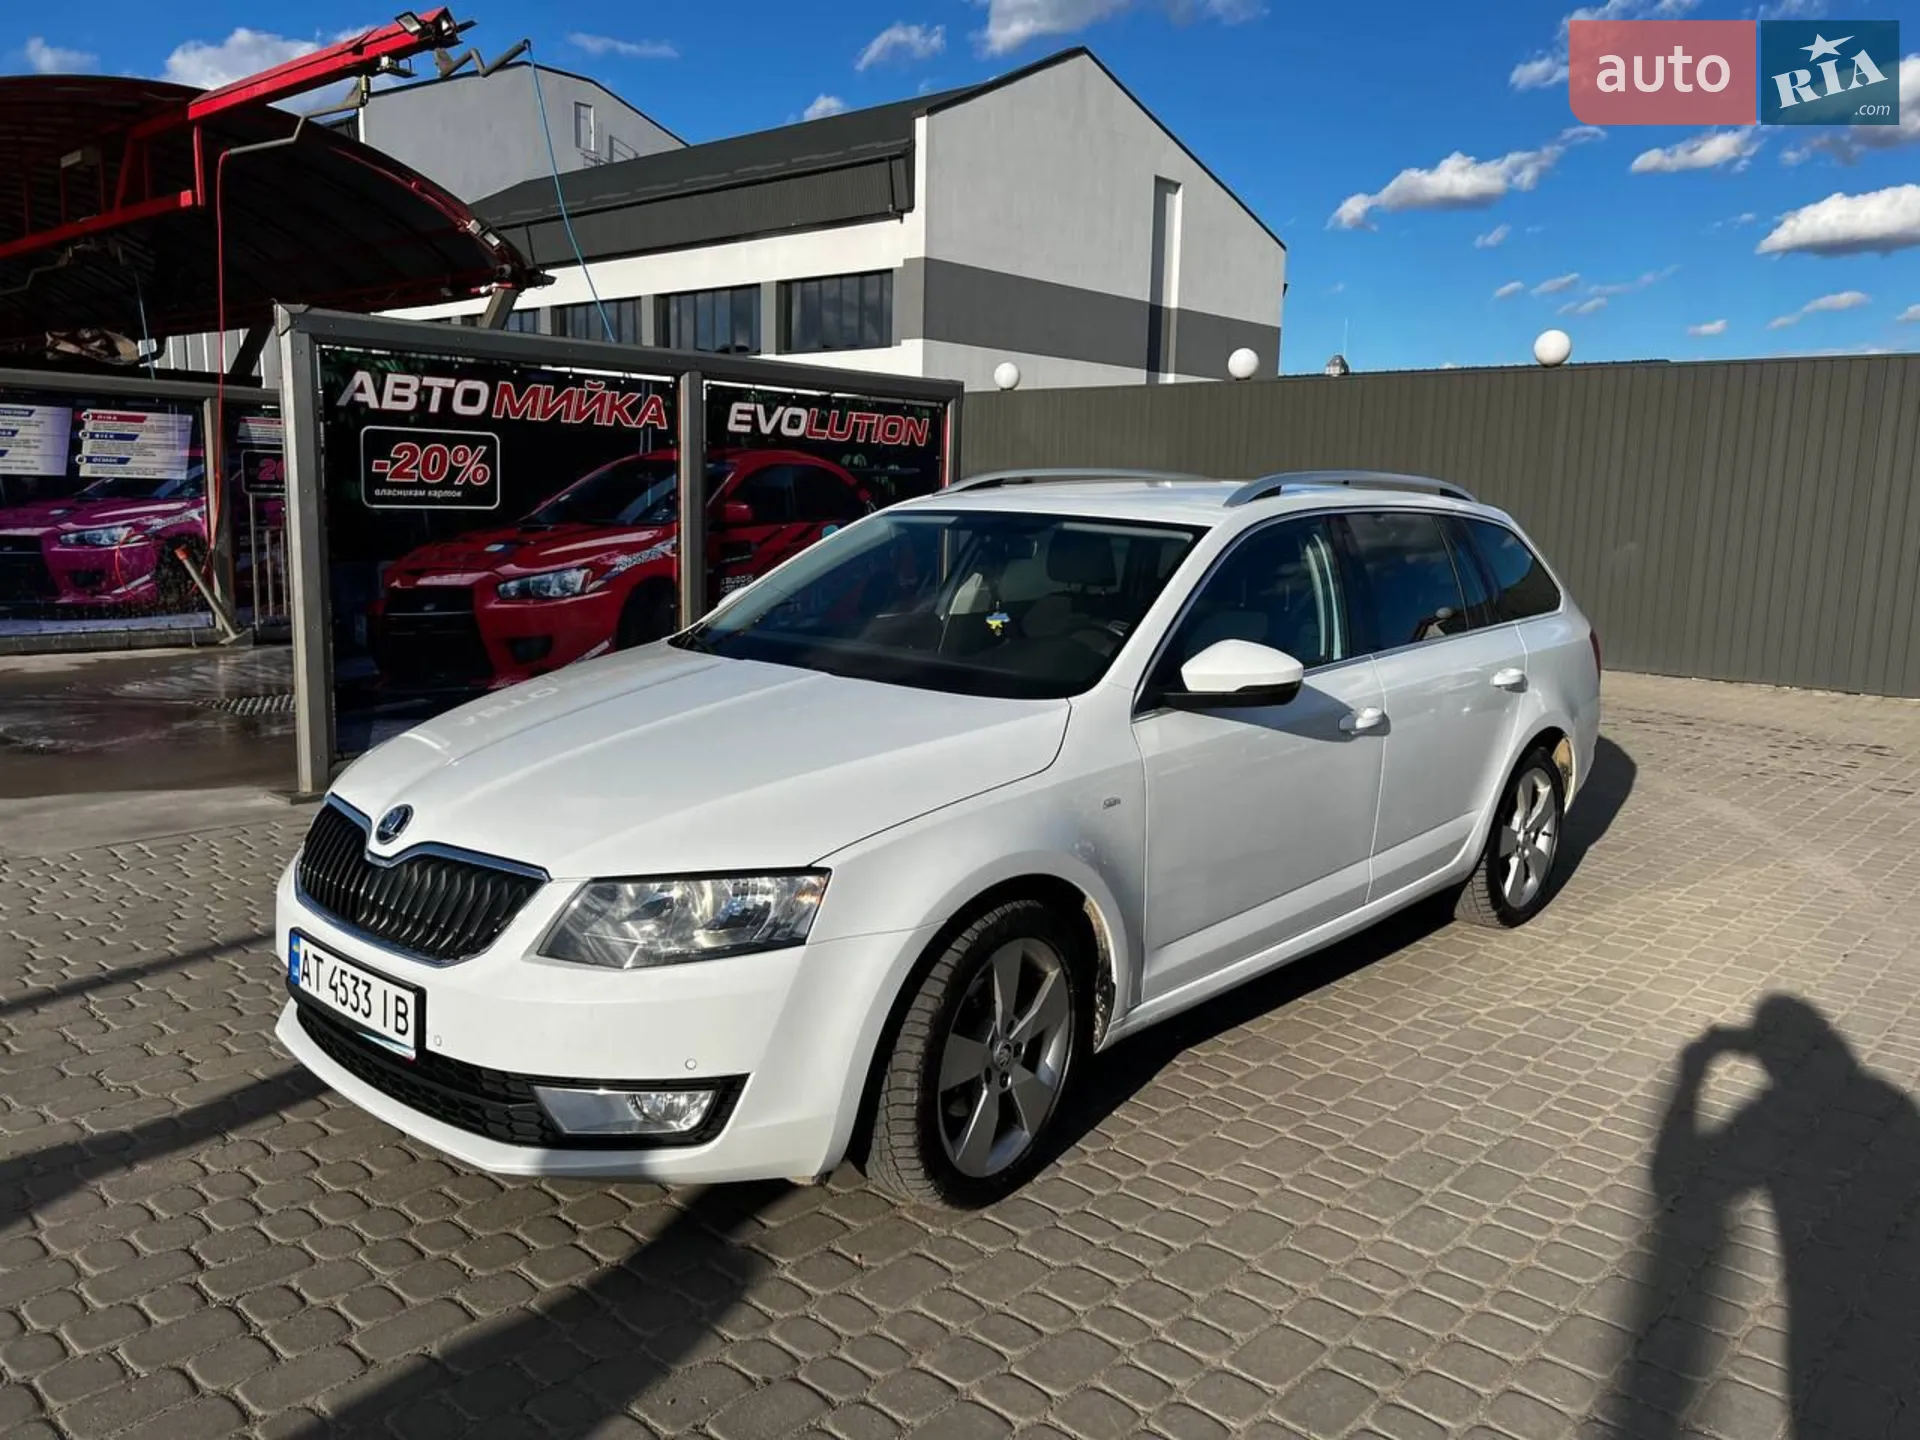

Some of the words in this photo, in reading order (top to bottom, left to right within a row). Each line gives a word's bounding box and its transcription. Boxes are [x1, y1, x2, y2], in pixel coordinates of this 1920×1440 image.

[336, 370, 668, 430] АВТОМИЙКА
[727, 402, 930, 447] EVOLUTION
[372, 442, 491, 486] -20%
[301, 949, 324, 992] AT
[328, 966, 372, 1019] 4533
[383, 989, 409, 1036] IB
